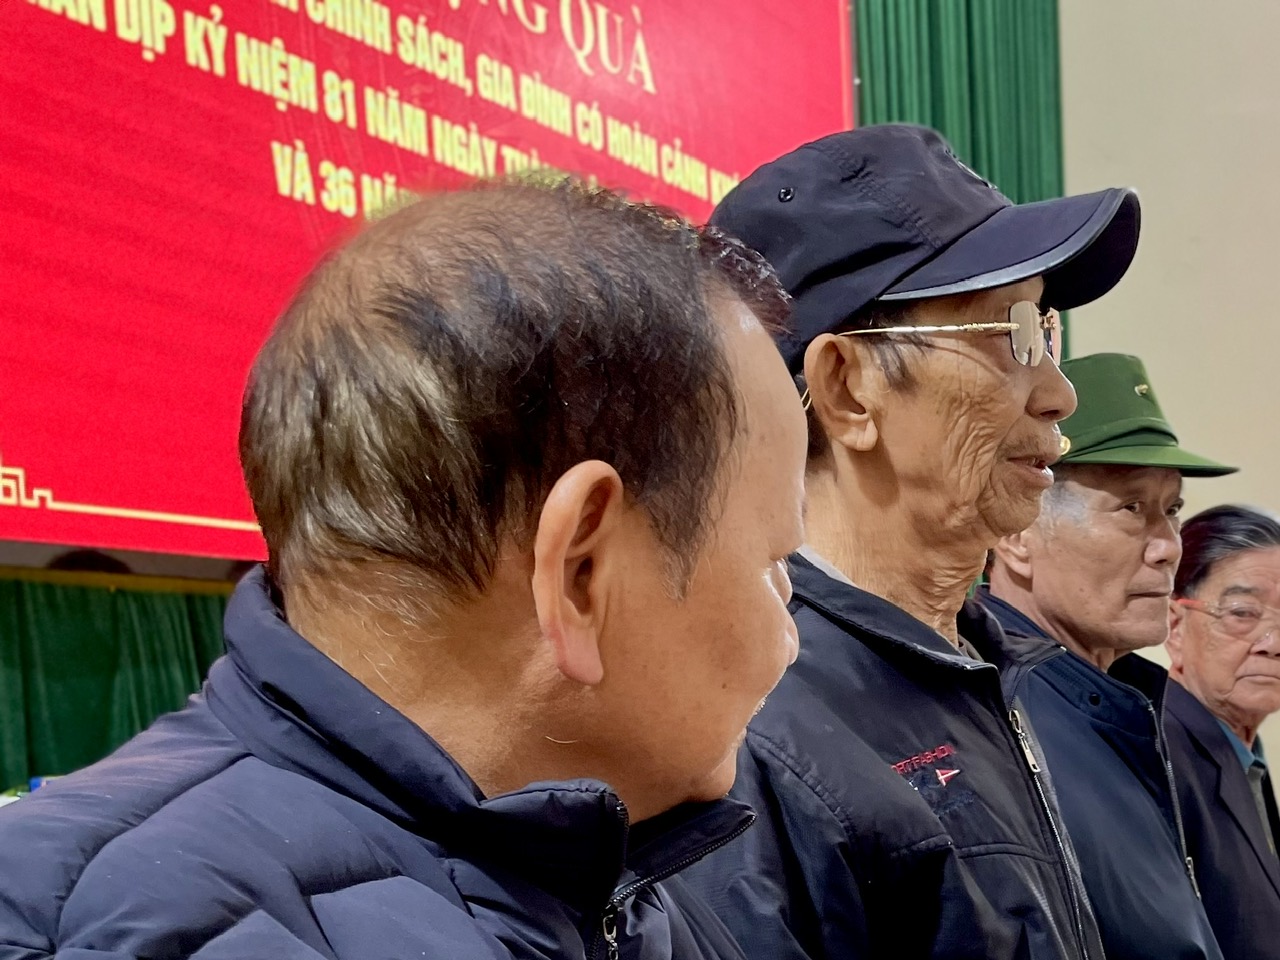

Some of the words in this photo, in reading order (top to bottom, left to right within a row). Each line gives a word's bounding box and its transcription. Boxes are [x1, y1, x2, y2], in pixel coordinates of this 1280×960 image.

[114, 0, 177, 62] DỊP
[183, 4, 228, 77] KỶ
[234, 32, 319, 112] NIỆM
[322, 70, 357, 129] 81
[364, 86, 429, 156] NĂM
[431, 115, 498, 178] NGÀY
[397, 14, 474, 97] SÁCH,
[476, 53, 518, 112] GIA
[519, 71, 573, 137] ĐÌNH
[575, 101, 605, 151] CÓ
[606, 115, 660, 178] HOÀN
[270, 139, 316, 205] VÀ
[318, 160, 357, 218] 36
